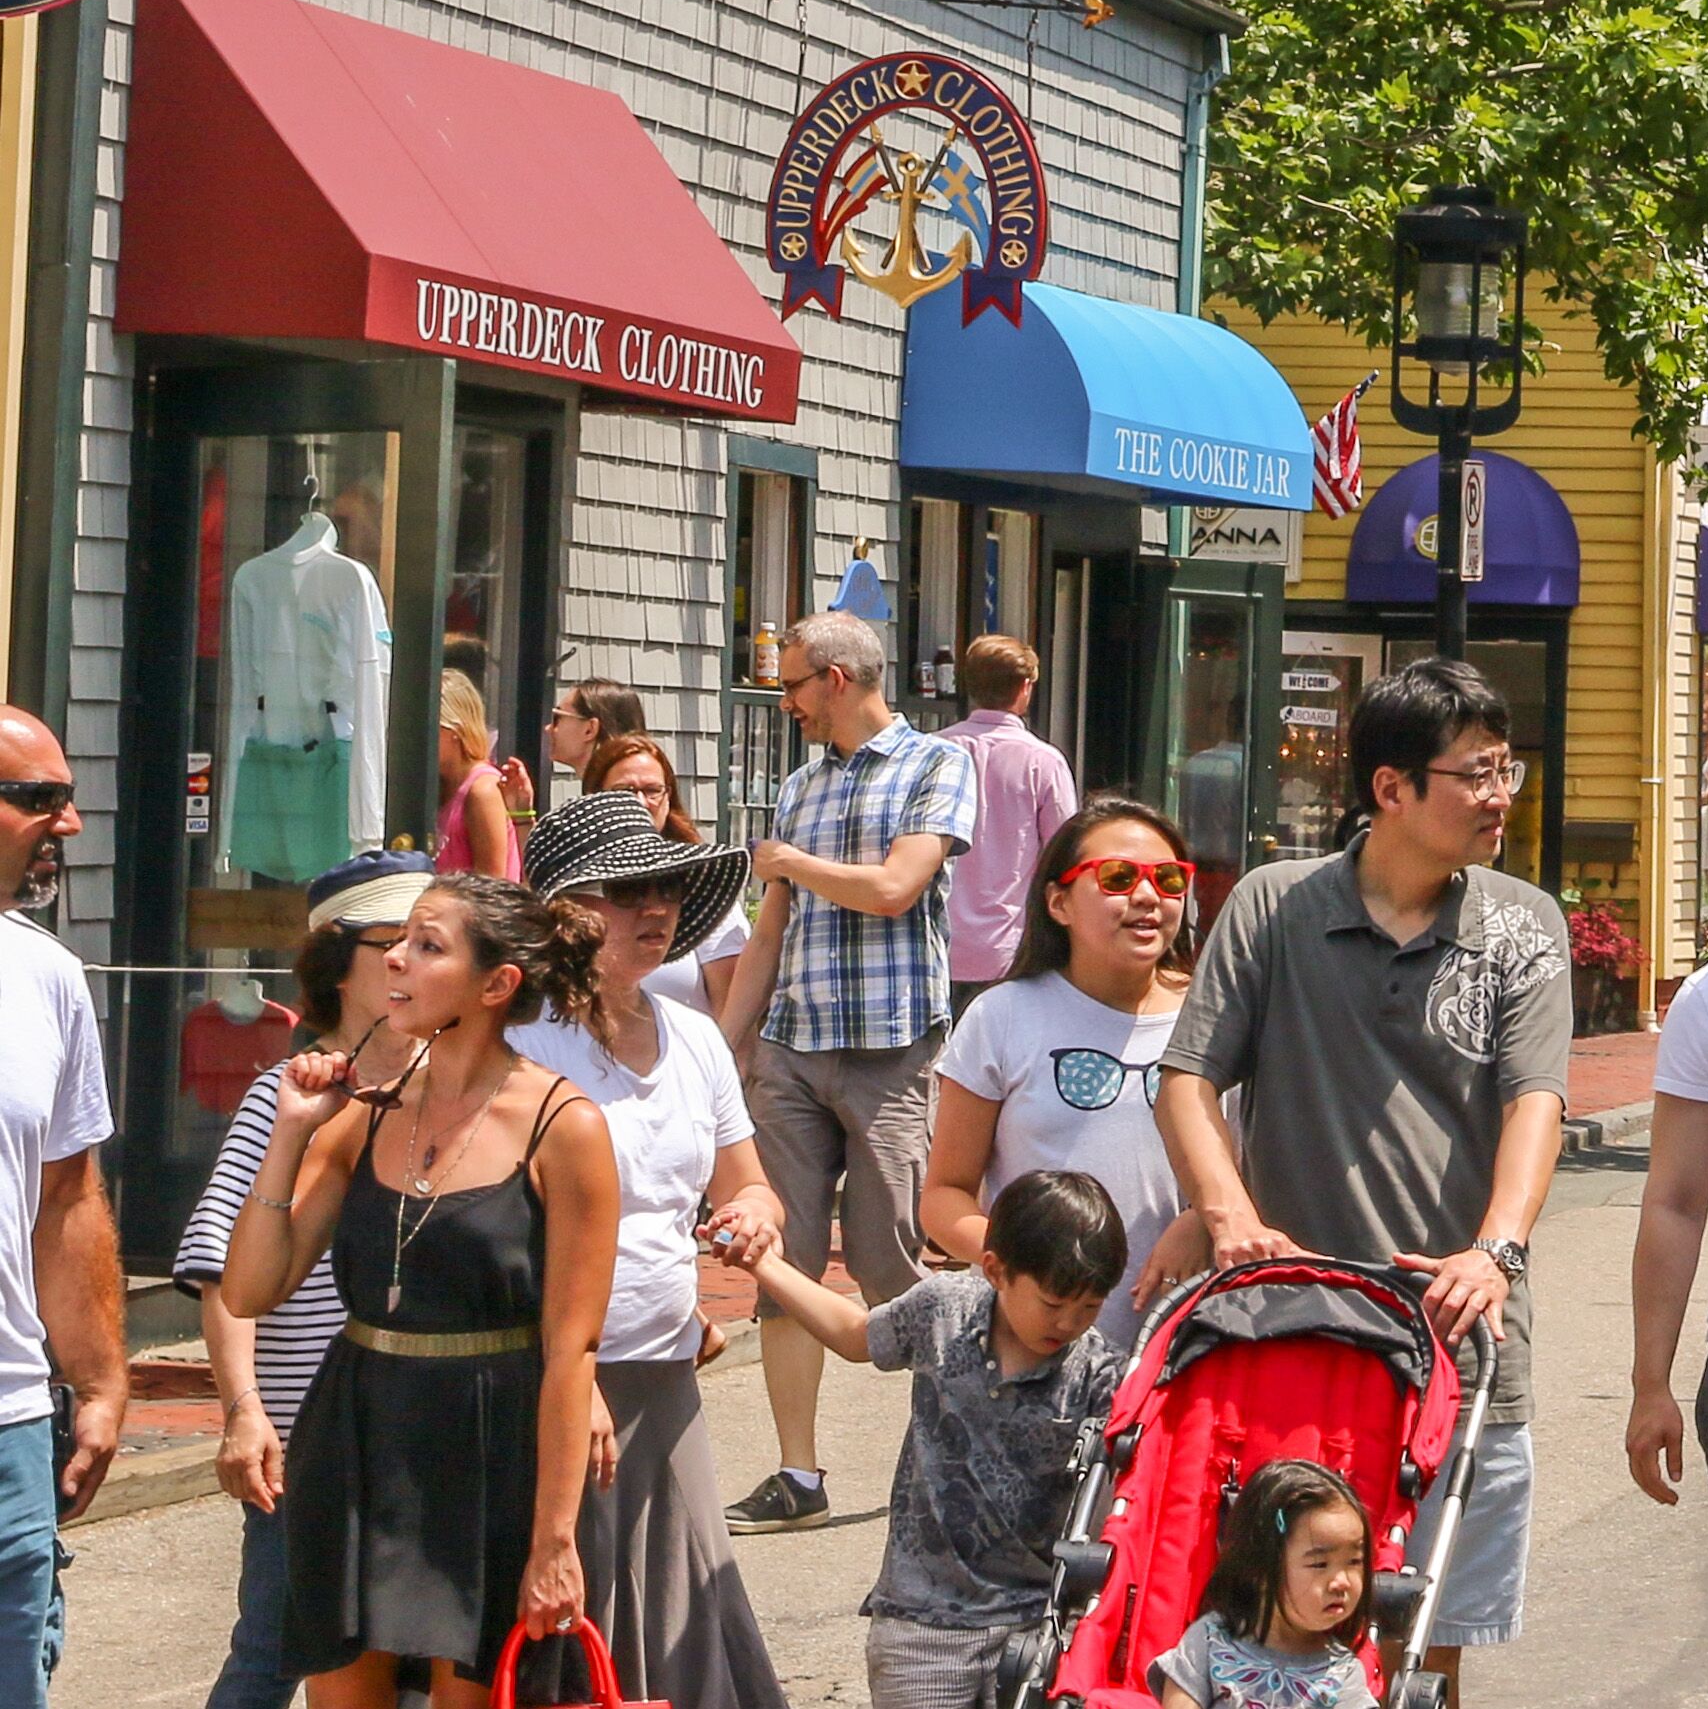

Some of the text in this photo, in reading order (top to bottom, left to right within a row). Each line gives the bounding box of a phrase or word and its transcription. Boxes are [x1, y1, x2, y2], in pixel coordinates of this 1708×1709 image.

[775, 66, 1035, 237] UPPERDECK CLOTHING
[416, 278, 765, 409] UPPERDECK CLOTHING
[1114, 427, 1290, 499] THE COOKIE JAR
